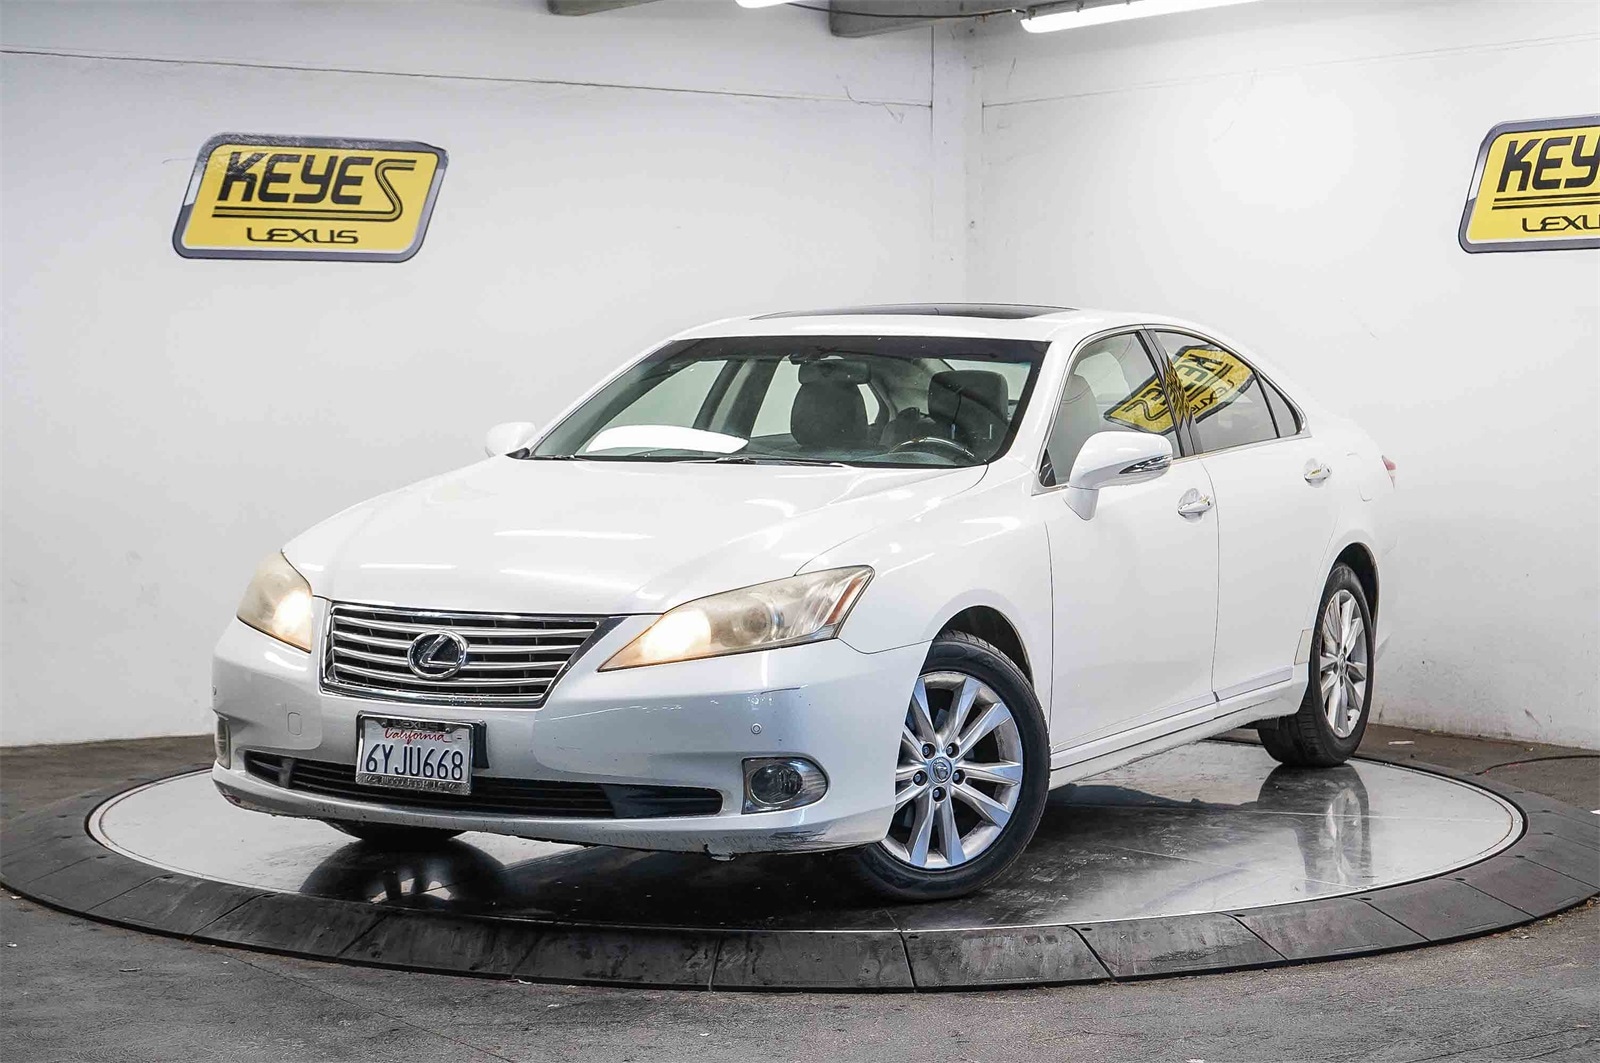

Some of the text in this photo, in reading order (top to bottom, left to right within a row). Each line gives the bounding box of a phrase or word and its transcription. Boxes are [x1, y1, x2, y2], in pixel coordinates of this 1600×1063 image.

[217, 151, 417, 221] KEYES
[246, 227, 359, 244] LEXUS
[384, 728, 453, 744] California
[365, 743, 463, 781] 6YJU668
